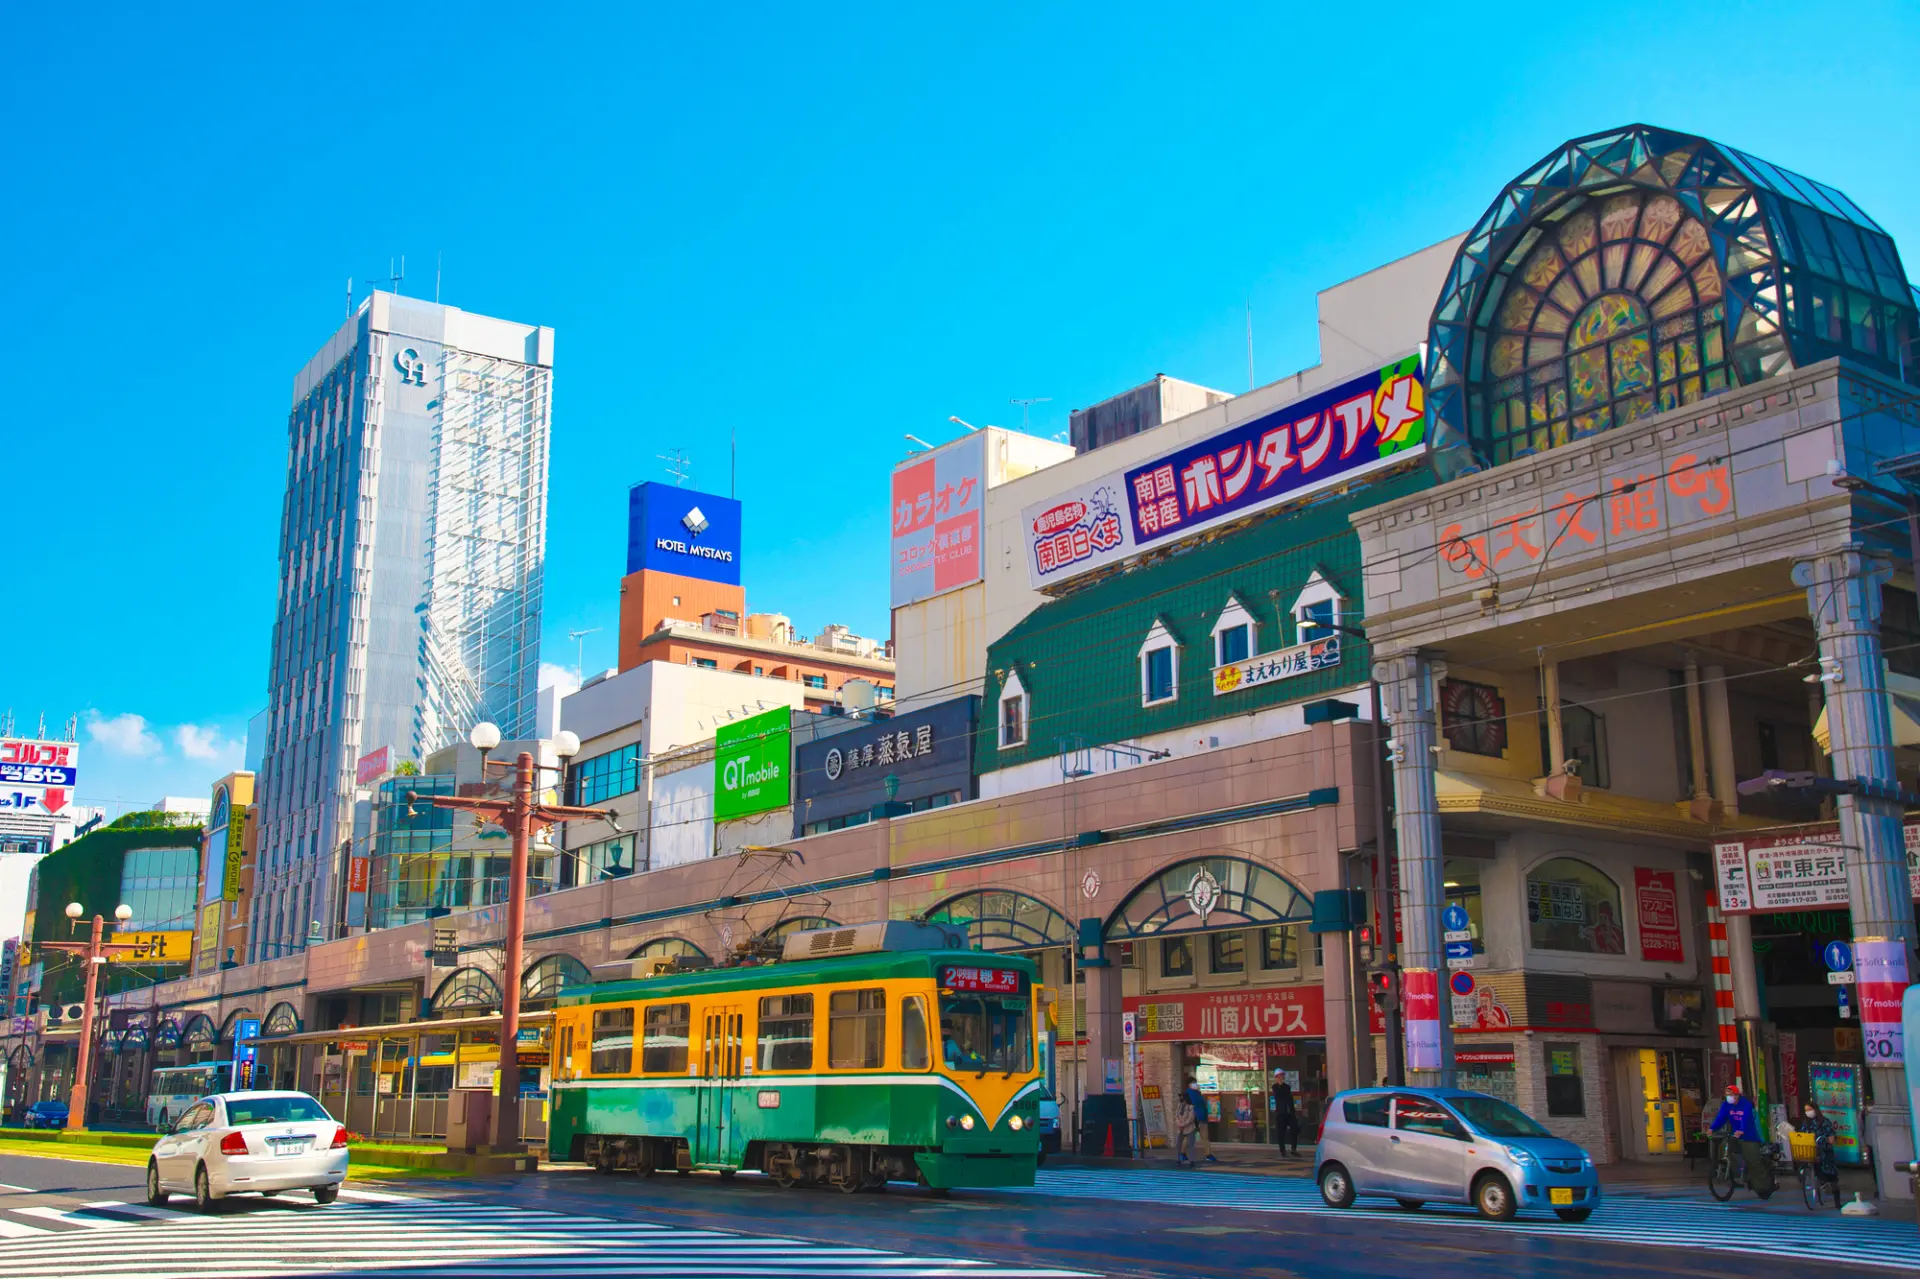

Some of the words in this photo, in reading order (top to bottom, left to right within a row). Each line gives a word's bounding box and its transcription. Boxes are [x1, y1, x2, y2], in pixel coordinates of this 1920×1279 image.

[1181, 374, 1425, 516] ボンタンアメ
[1133, 463, 1176, 505] 南国
[895, 476, 978, 532] カラオケ
[1138, 495, 1182, 536] 特産
[1493, 473, 1661, 570] 天文館
[657, 538, 687, 553] HOTEL
[690, 545, 732, 562] MYSTAYS
[1037, 518, 1120, 571] 南国白くま
[1245, 651, 1309, 684] まえわり屋
[2, 743, 69, 766] ゴルフ用品
[0, 766, 67, 784] つるや
[946, 968, 957, 986] 2
[1200, 1004, 1308, 1036] 川商ハウス
